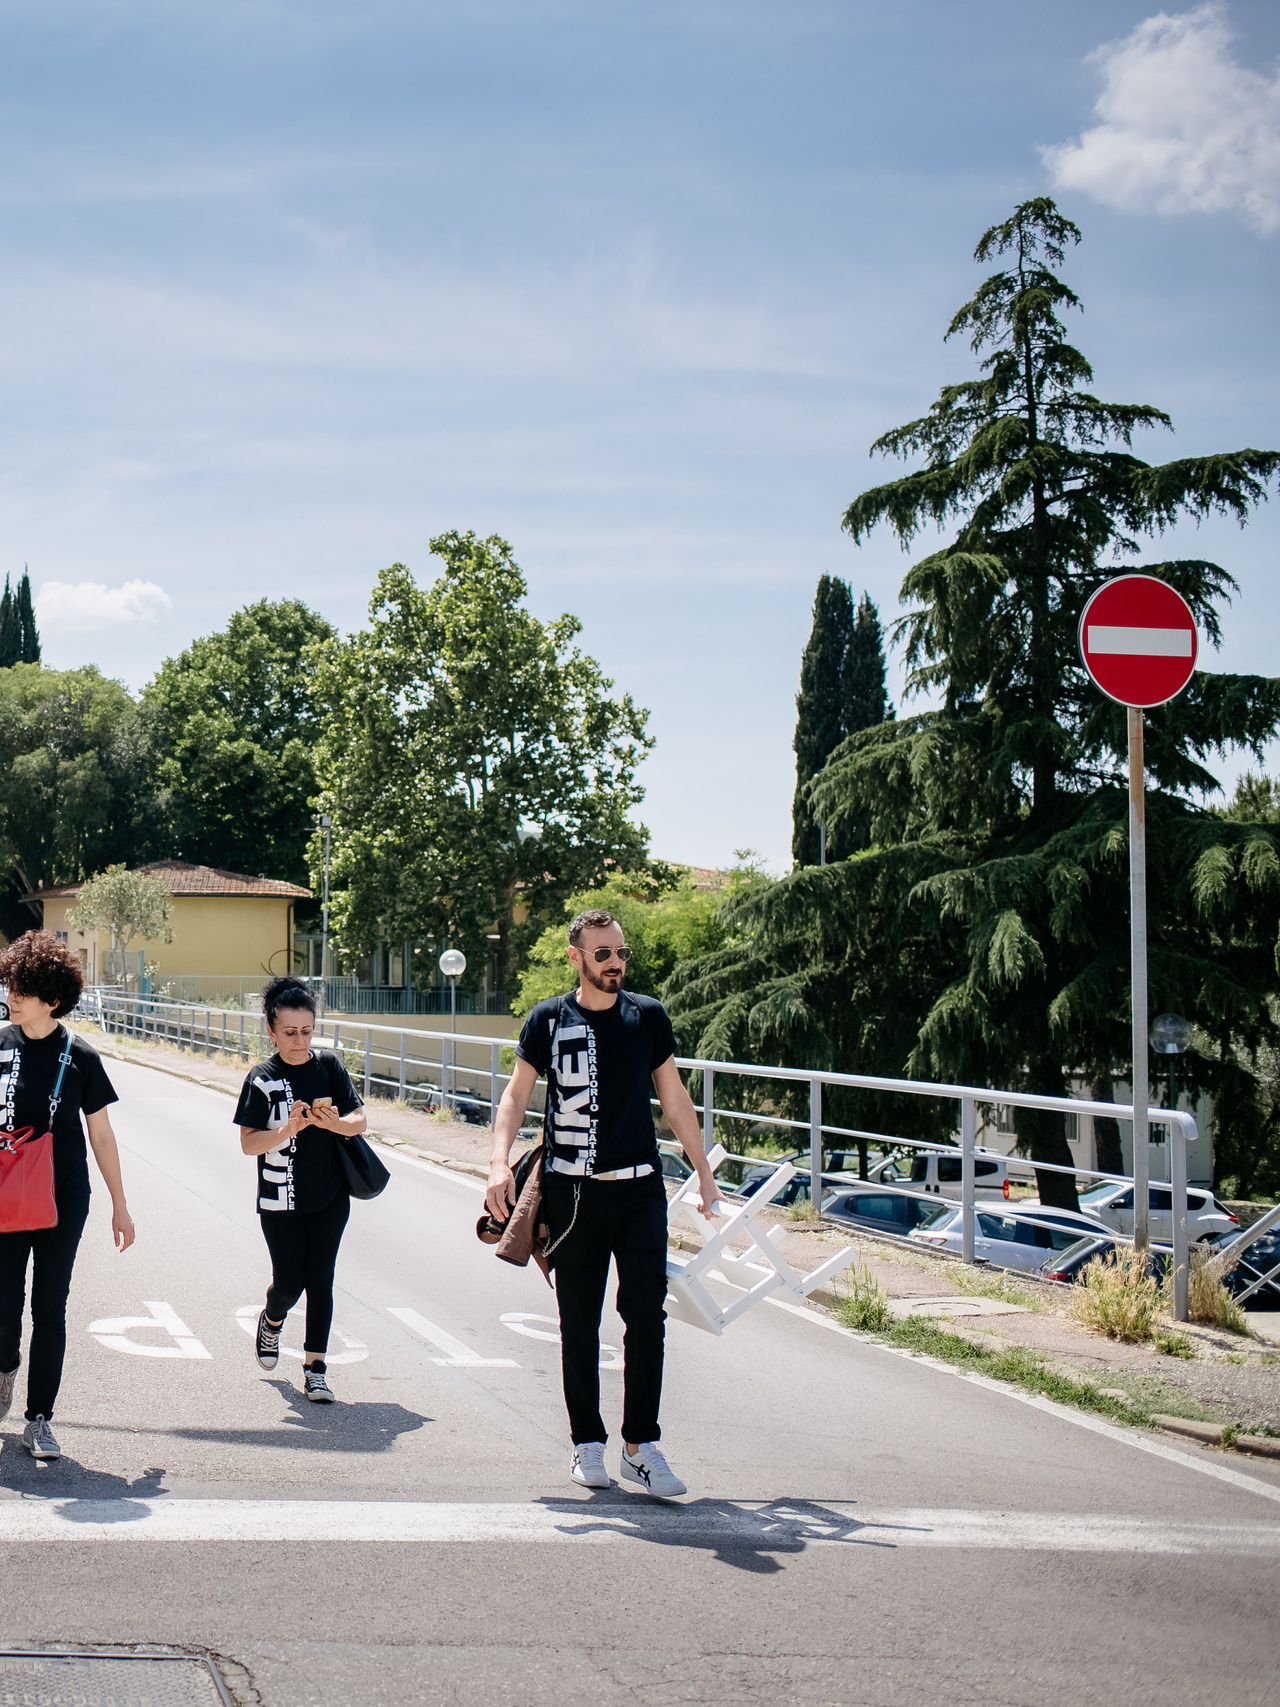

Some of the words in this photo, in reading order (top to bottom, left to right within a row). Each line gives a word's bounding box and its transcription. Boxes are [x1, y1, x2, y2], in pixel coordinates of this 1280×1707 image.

[6, 1049, 21, 1131] LABORATORIO
[586, 1024, 599, 1112] LABORATORIO
[585, 1119, 599, 1176] TEATRALE
